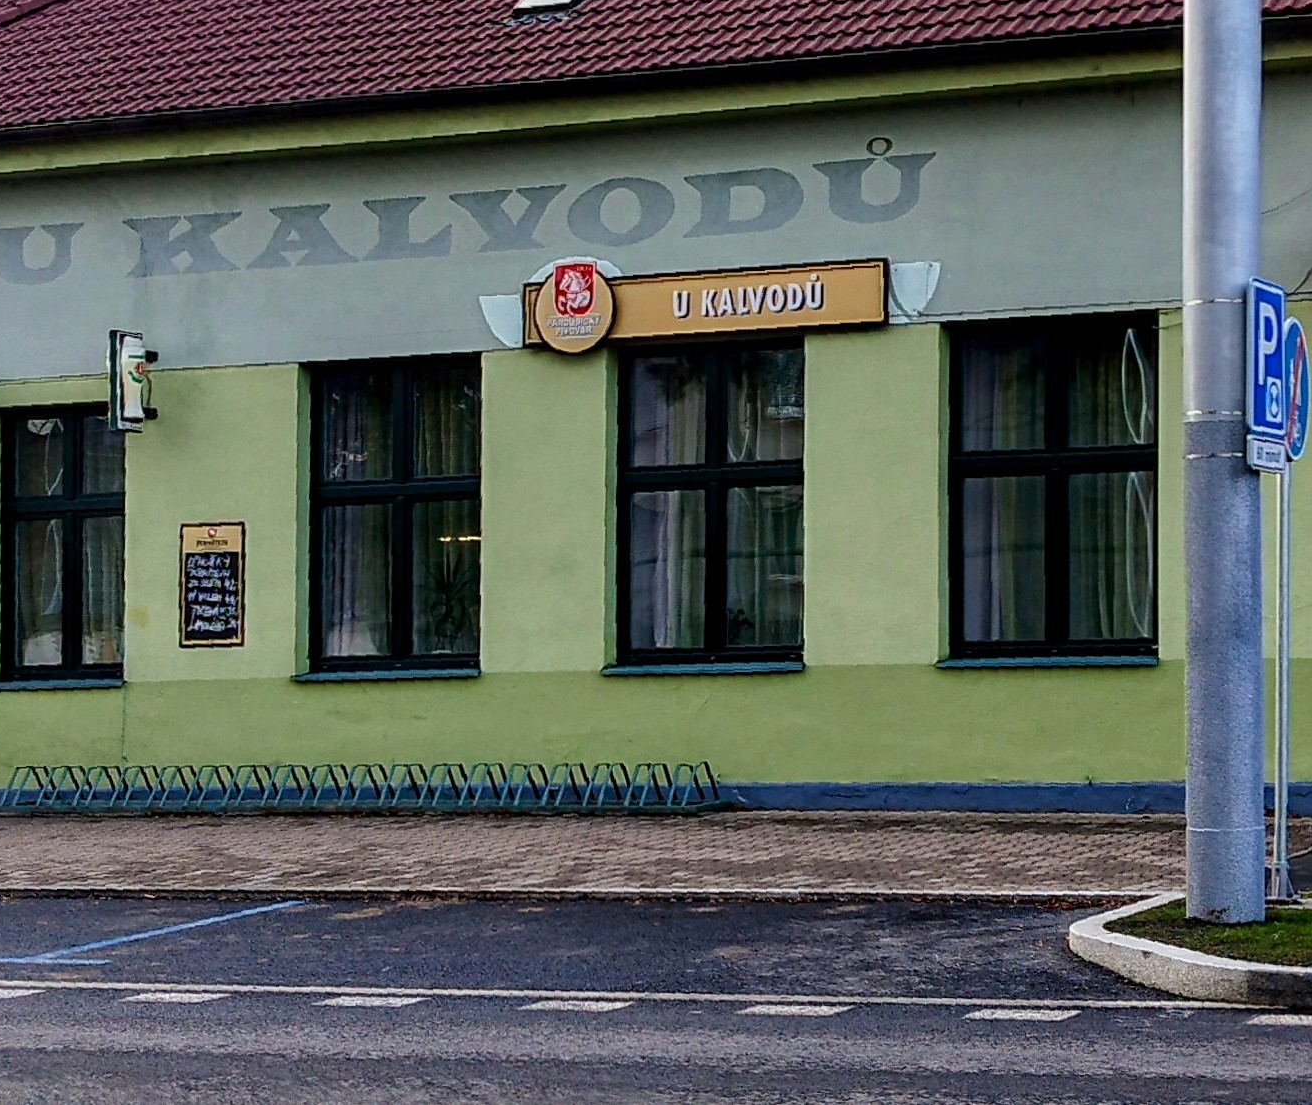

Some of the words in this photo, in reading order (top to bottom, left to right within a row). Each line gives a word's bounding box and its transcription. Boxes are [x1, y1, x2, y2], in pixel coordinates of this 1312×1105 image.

[123, 136, 937, 280] KALVODŮ
[673, 290, 690, 319] U
[700, 273, 824, 318] KALVODŮ
[1257, 301, 1278, 385] P
